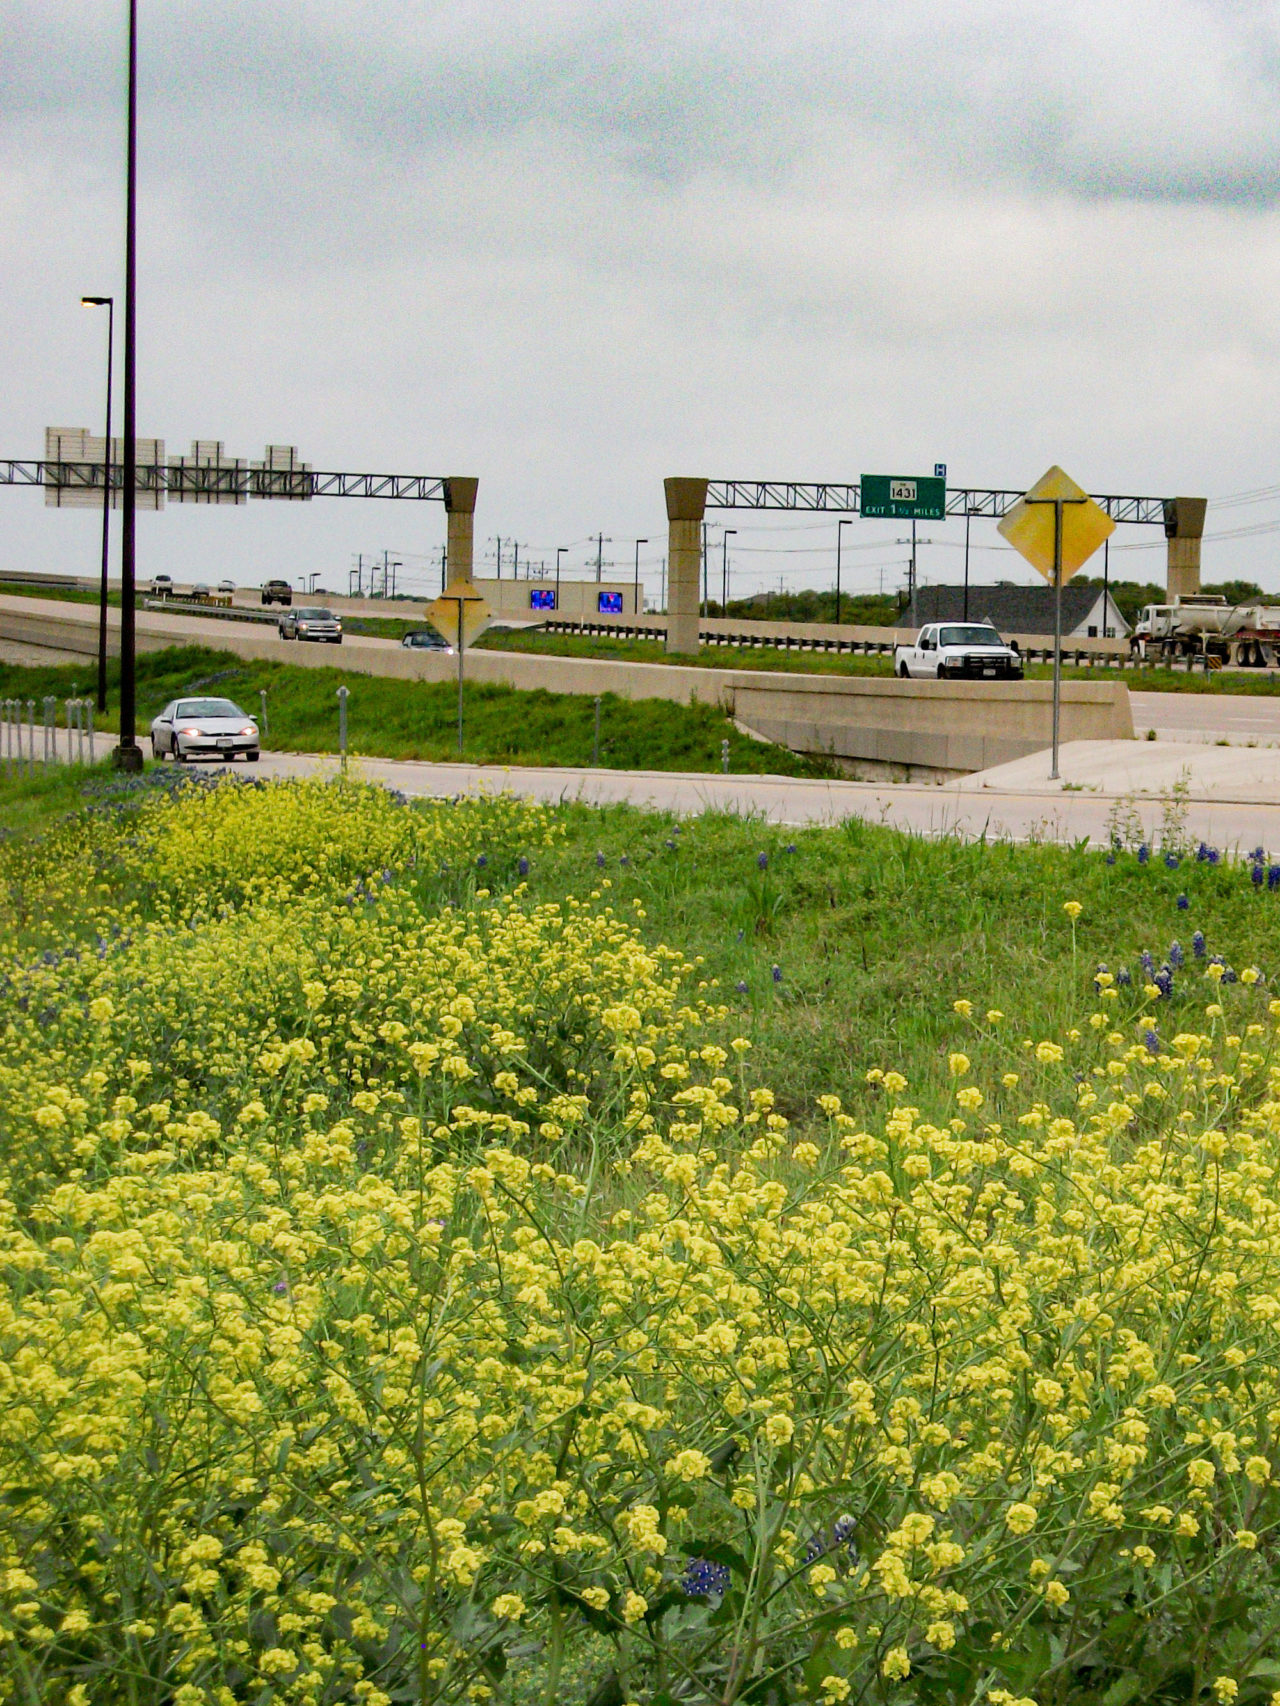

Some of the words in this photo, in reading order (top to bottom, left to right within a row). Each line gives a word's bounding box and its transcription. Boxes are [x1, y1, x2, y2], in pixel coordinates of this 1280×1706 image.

[892, 487, 915, 498] 1431
[865, 505, 884, 514] EXIT
[913, 507, 940, 516] MILES
